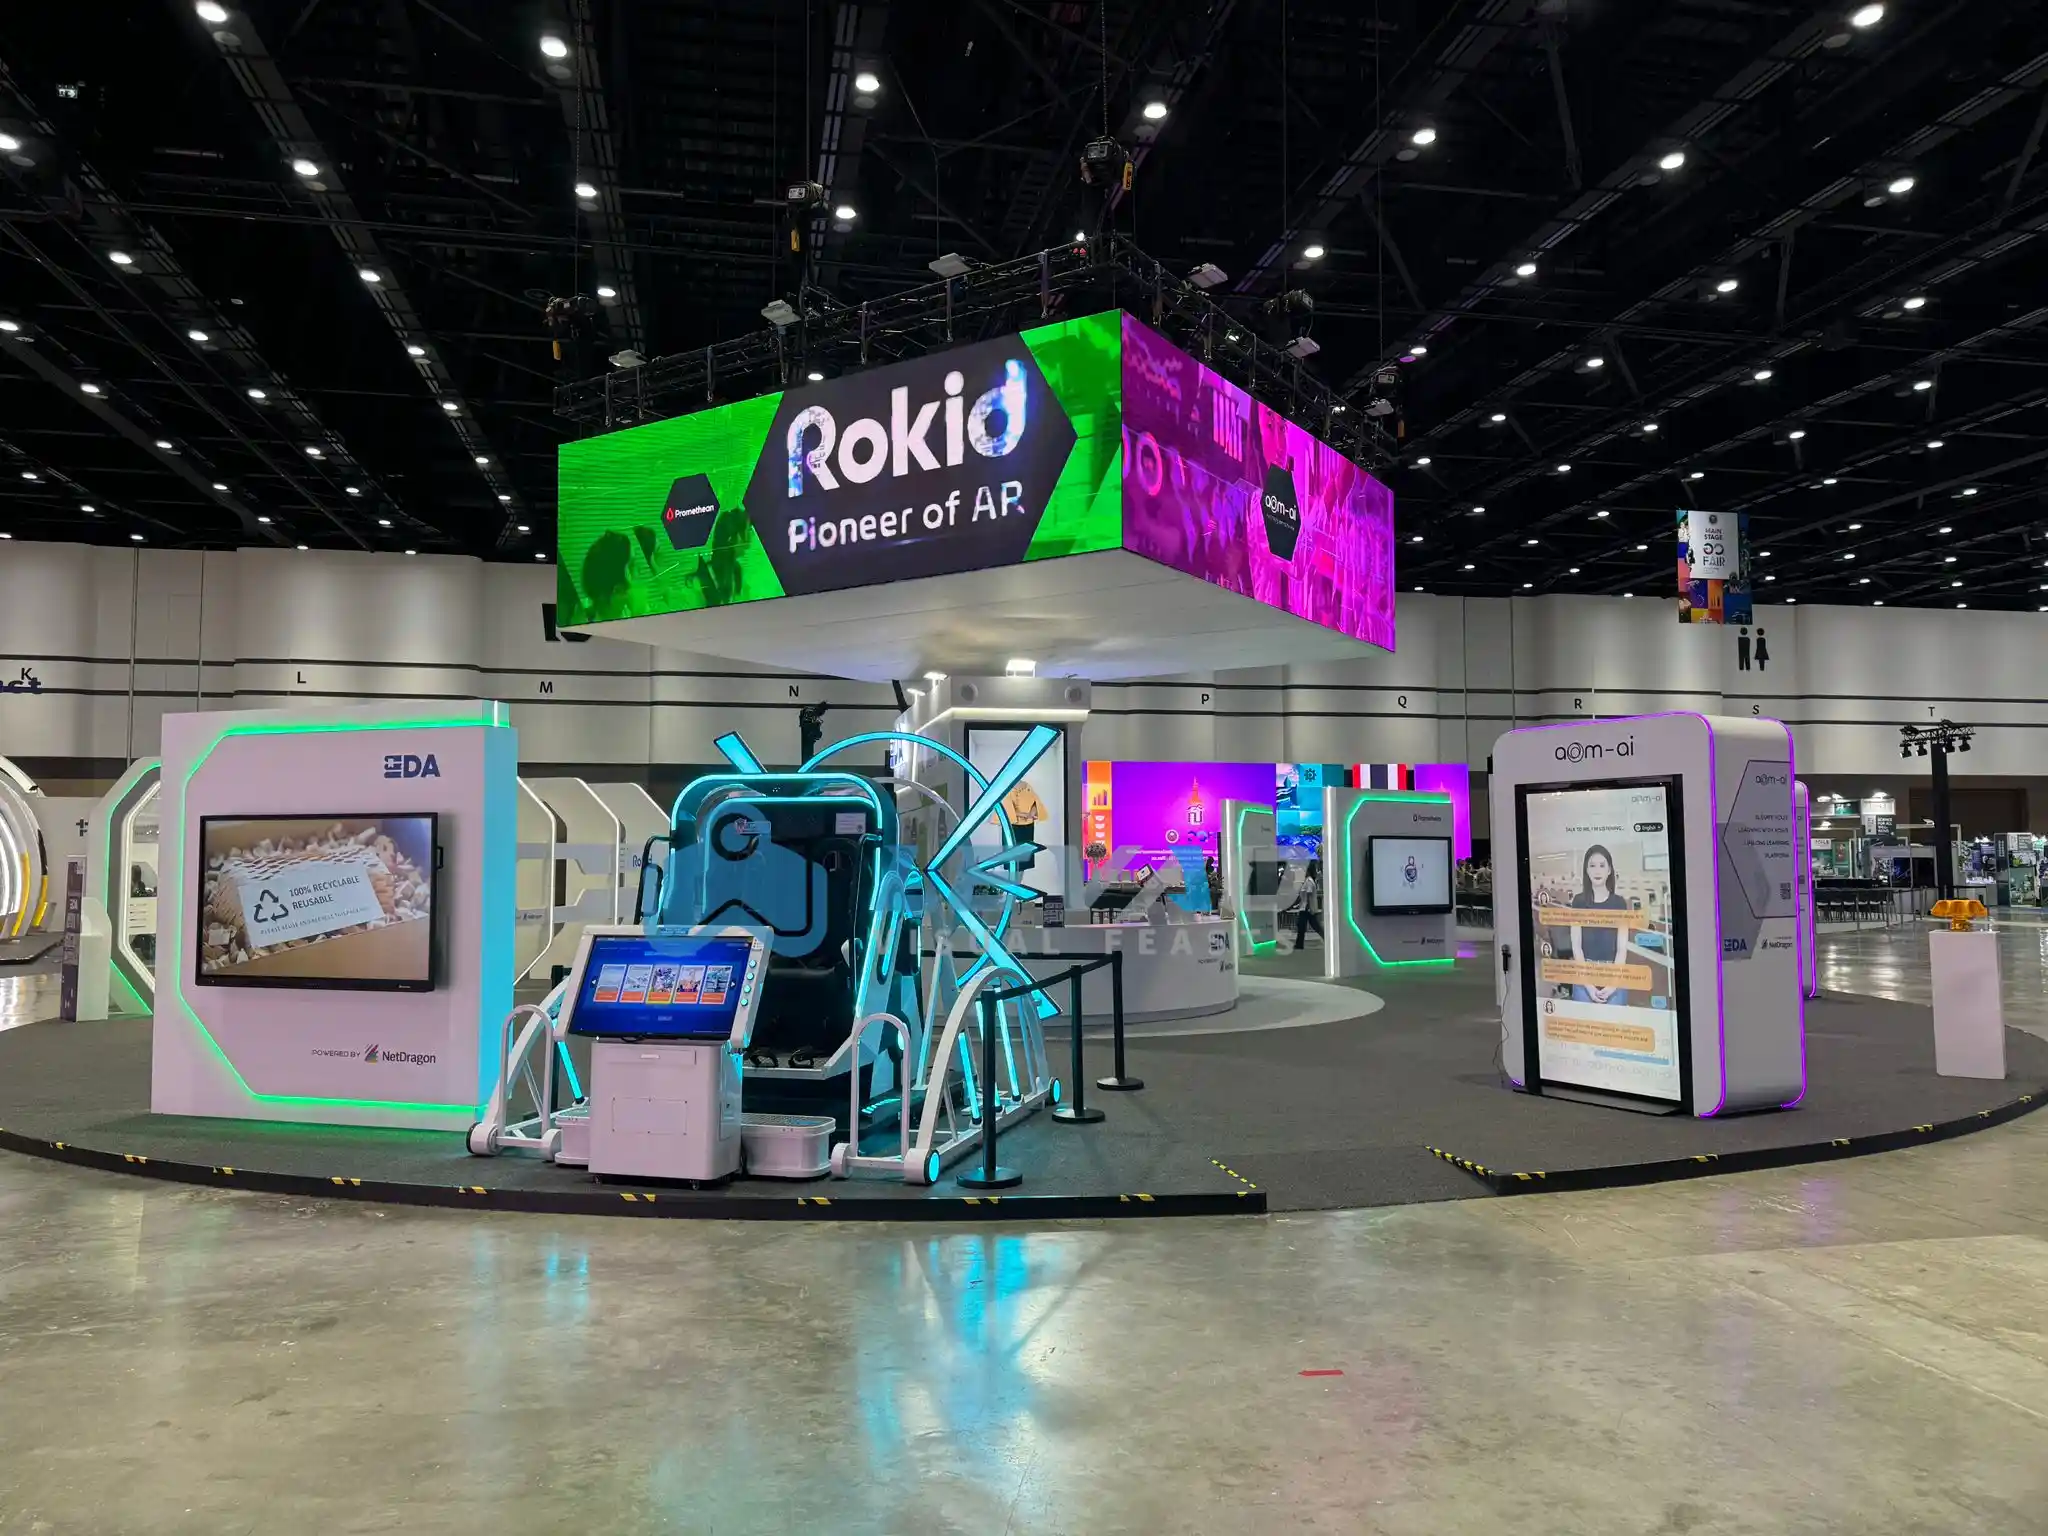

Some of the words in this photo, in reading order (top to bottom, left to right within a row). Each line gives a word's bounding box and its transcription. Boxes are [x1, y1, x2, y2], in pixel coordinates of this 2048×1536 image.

[787, 359, 1027, 498] Rokid
[674, 504, 715, 519] Promethean
[788, 507, 912, 554] Pioneer
[922, 490, 960, 530] of
[971, 480, 1025, 522] AR
[1702, 556, 1726, 567] FAIR
[21, 667, 33, 681] K
[298, 674, 307, 684] L
[539, 681, 553, 694] M
[789, 685, 799, 697] N
[1201, 694, 1209, 704] P
[1398, 696, 1407, 708] Q
[1574, 698, 1583, 710] R
[1752, 704, 1760, 715] S
[1927, 706, 1936, 717] T
[383, 753, 442, 779] EDA
[288, 885, 312, 898] 100%
[312, 875, 361, 893] RECYCLABLE
[291, 893, 335, 911] REUSABLE
[1723, 938, 1748, 952] EDA
[311, 1048, 349, 1058] POWERED
[350, 1049, 361, 1059] BY
[382, 1050, 437, 1066] NetDragon
